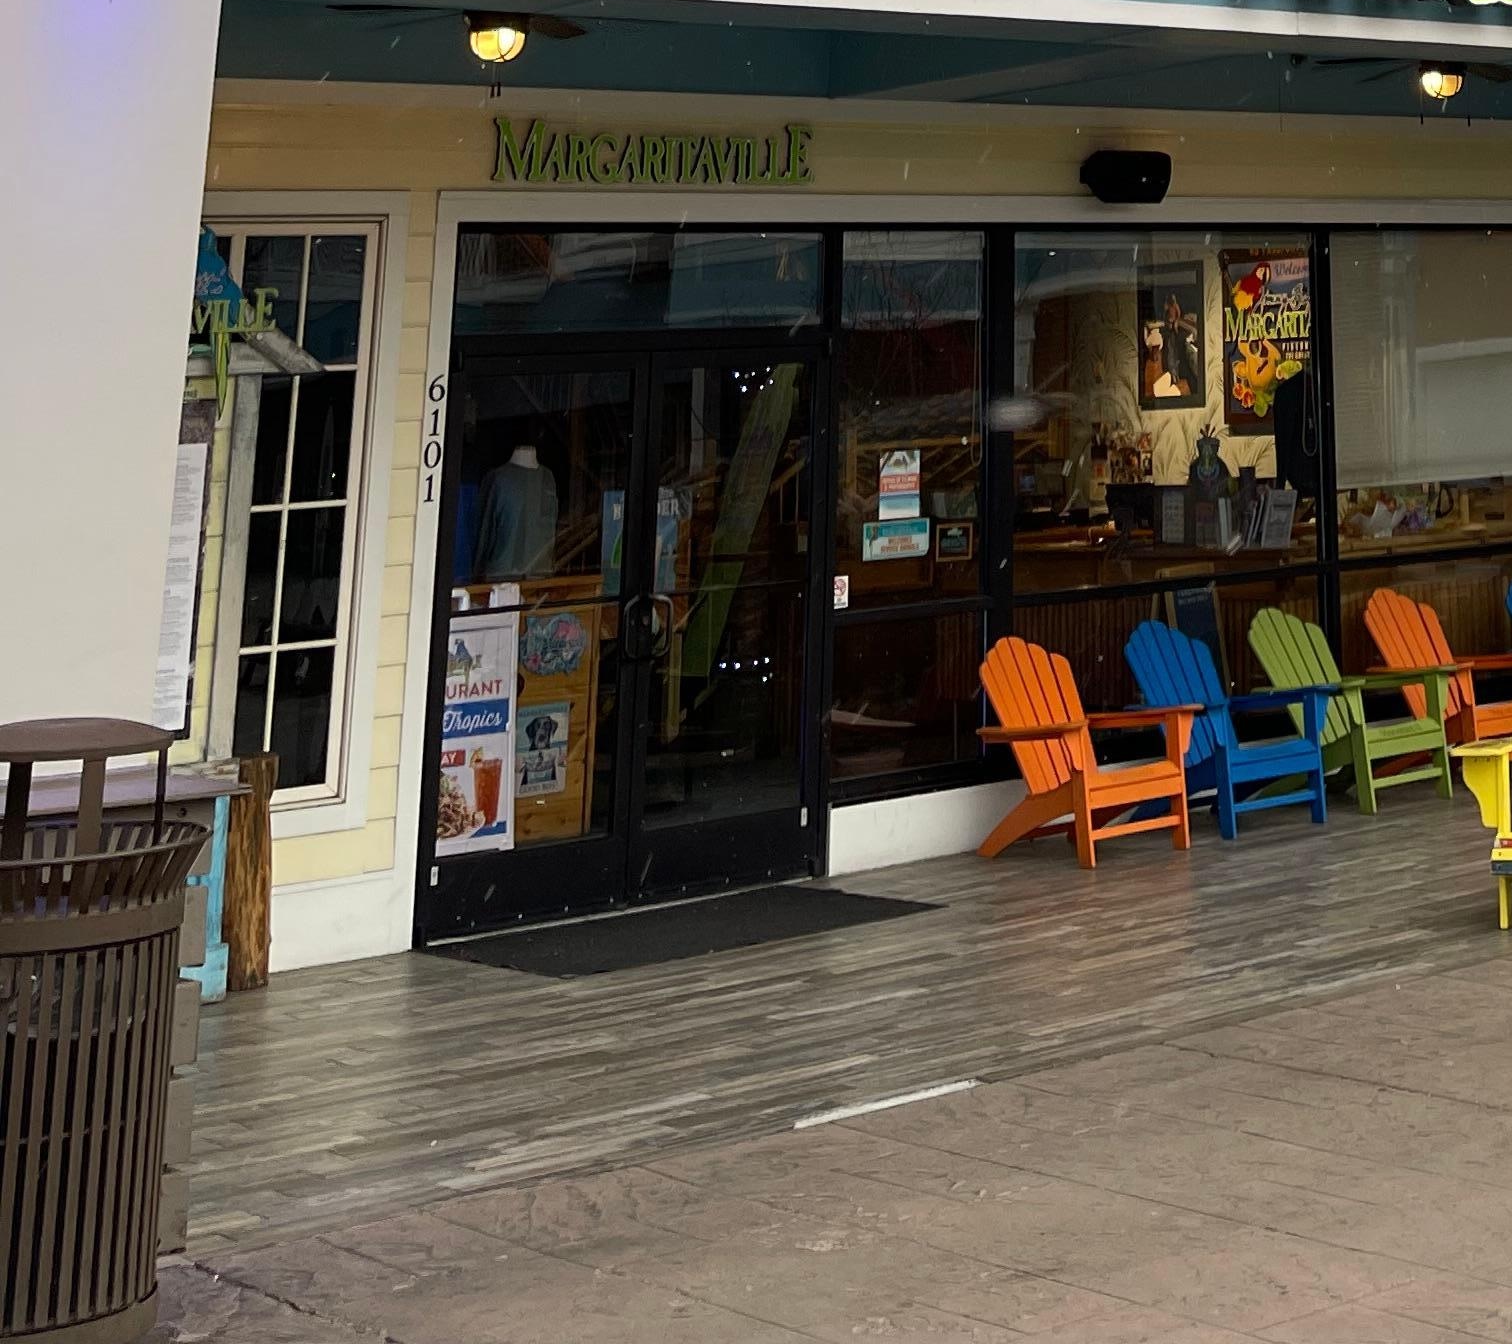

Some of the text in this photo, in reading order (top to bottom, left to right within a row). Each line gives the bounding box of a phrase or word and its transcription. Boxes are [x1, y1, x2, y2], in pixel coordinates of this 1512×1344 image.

[491, 117, 815, 186] MARGARITAVILLE
[422, 373, 446, 504] 6101
[443, 710, 503, 733] Tropics
